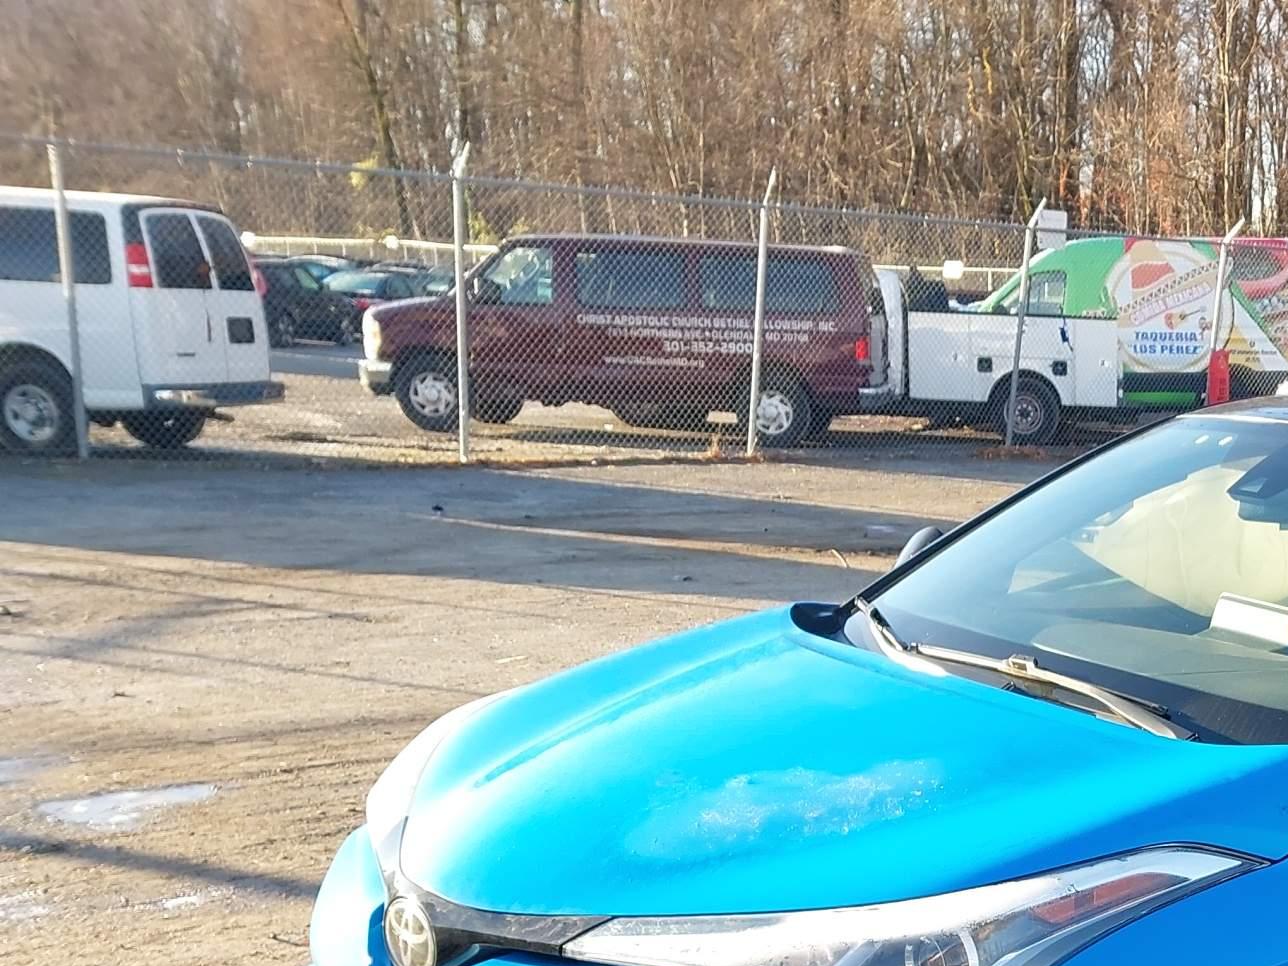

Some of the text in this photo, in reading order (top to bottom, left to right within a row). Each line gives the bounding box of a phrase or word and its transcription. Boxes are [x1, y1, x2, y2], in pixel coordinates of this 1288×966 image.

[577, 314, 612, 325] CHRIST
[614, 315, 668, 326] APOSTOLIC
[672, 316, 712, 327] CHURCH
[713, 318, 750, 329] BETHEL
[1135, 331, 1198, 342] TAQUERIA
[663, 340, 753, 353] 301-352-2900
